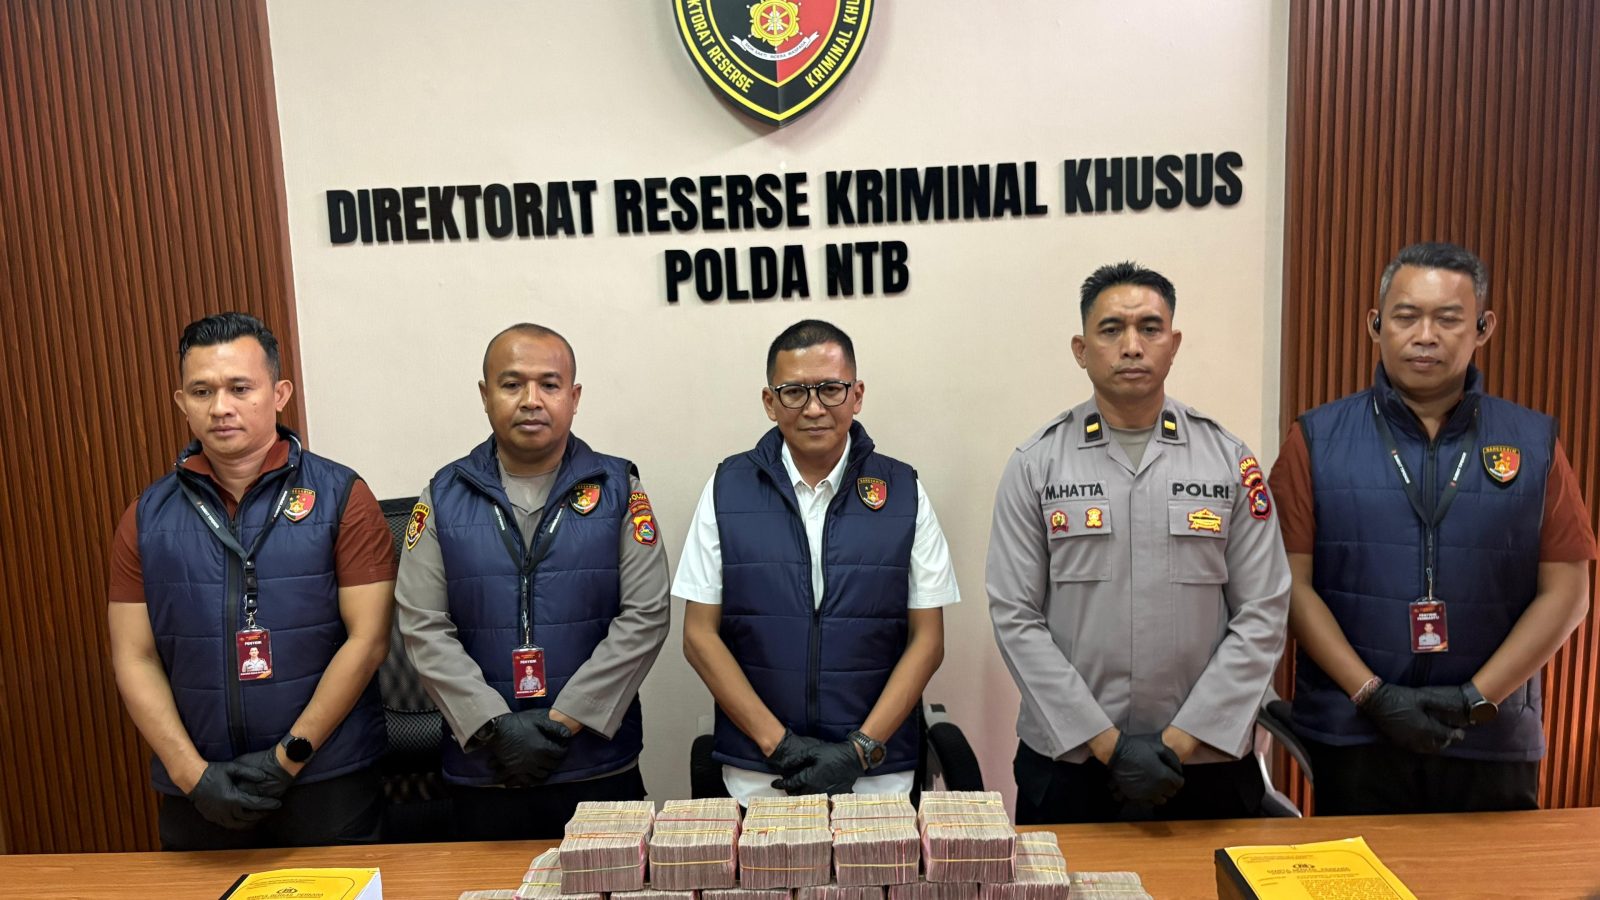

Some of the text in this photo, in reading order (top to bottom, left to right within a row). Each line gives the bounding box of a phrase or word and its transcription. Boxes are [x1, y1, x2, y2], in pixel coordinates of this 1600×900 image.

[707, 45, 754, 93] RESERSE
[805, 30, 853, 88] KRIMINAL
[326, 152, 1244, 244] DIREKTORAT RESERSE KRIMINAL KHUSUS
[664, 240, 910, 304] POLDA NTB
[1046, 483, 1104, 499] M.HATTA
[1172, 482, 1229, 499] POLRI
